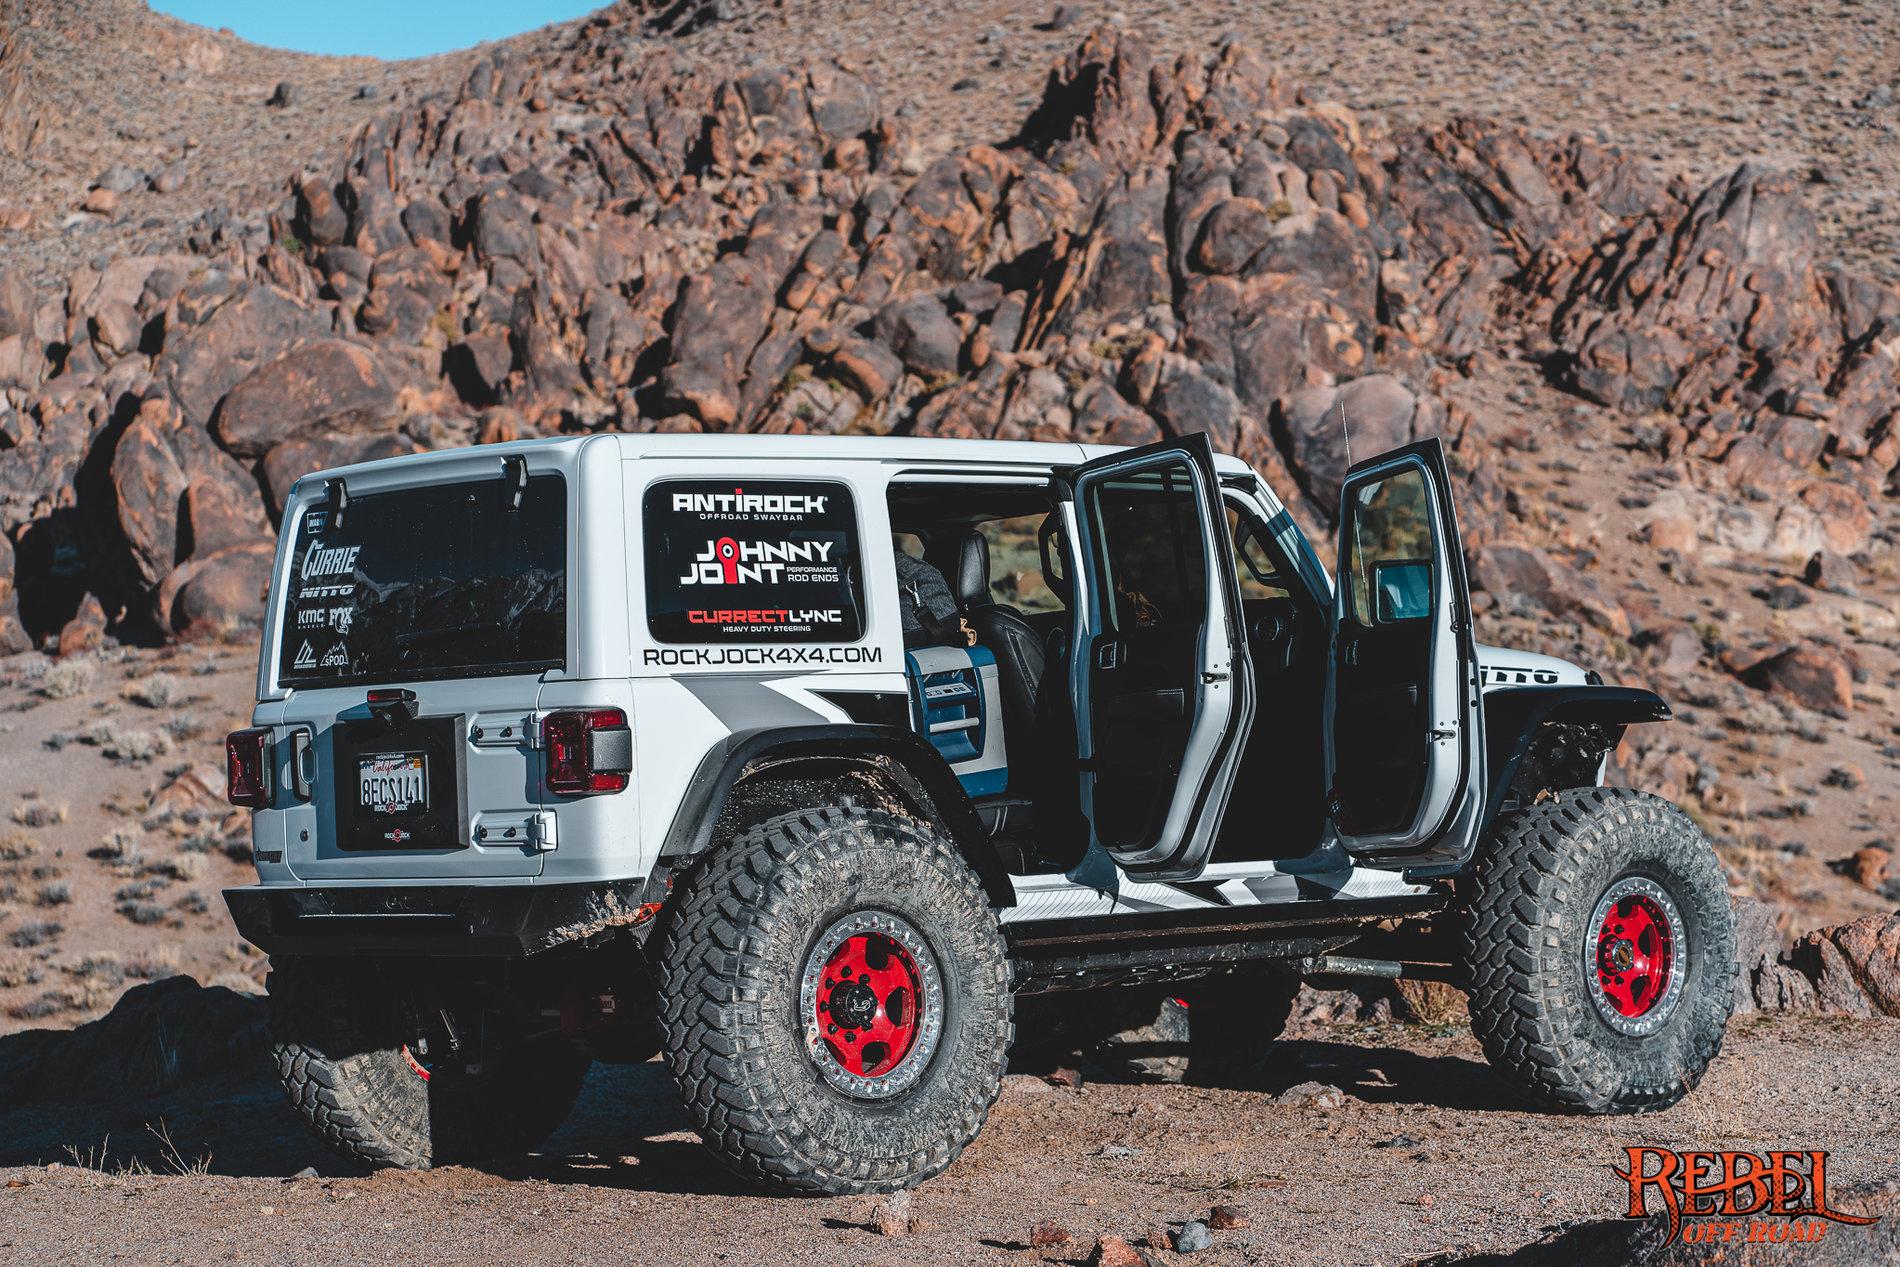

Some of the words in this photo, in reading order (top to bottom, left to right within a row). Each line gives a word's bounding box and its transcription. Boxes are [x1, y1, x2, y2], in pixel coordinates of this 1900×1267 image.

[699, 513, 749, 521] OFFROAD
[753, 513, 803, 521] SWAYBAR
[301, 539, 361, 581] CURRIE
[696, 537, 834, 562] JOHNNY
[680, 562, 785, 585] JOINT
[787, 574, 810, 582] ROD
[812, 574, 839, 582] ENDS
[299, 584, 356, 598] NITTO
[328, 607, 354, 634] FOX
[687, 609, 842, 624] CURRECTLYNC
[722, 625, 749, 633] HEAVY
[750, 625, 772, 633] DUTY
[773, 625, 811, 633] STEERING
[643, 647, 882, 666] ROCKJOCK4X4.COM
[1479, 665, 1559, 688] ITTO
[362, 776, 422, 805] 8ECS141
